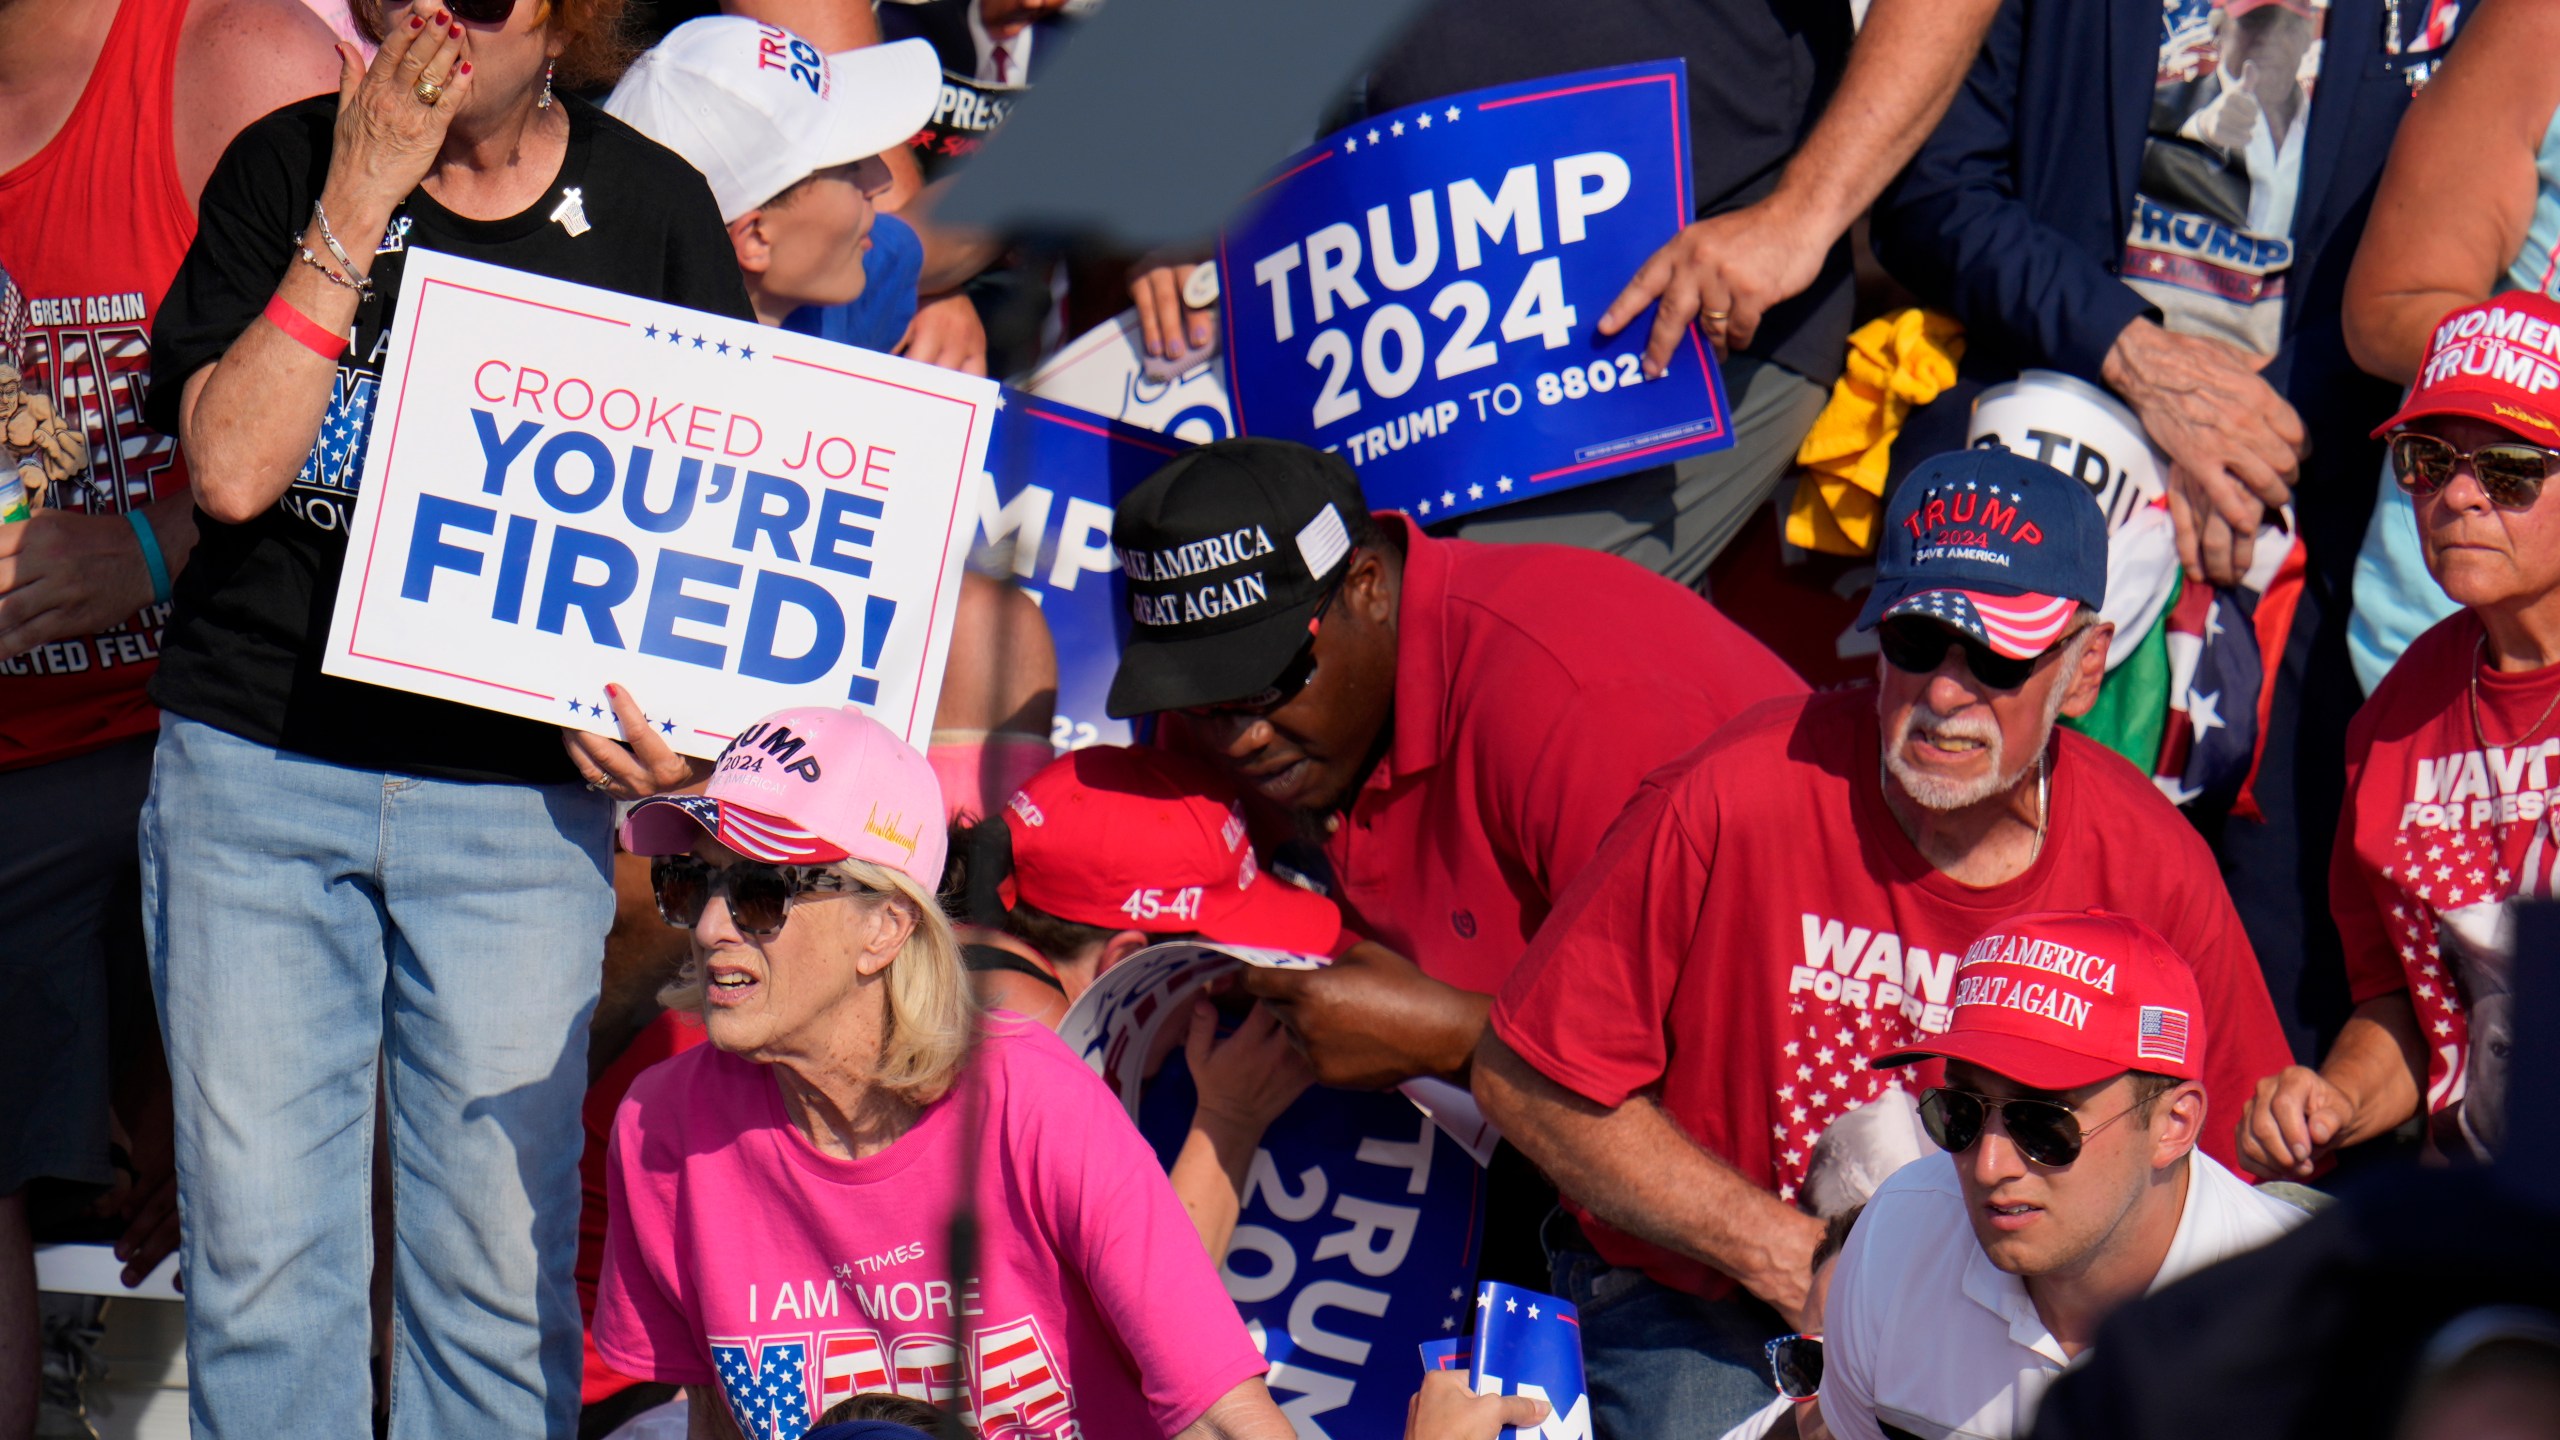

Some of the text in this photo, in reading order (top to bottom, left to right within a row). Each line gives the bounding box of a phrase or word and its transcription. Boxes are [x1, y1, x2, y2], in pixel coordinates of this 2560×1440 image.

[932, 83, 1015, 130] PRES
[1254, 151, 1632, 343] TRUMP
[30, 292, 147, 327] GREAT AGAIN
[2433, 306, 2560, 354] WOMEN
[1305, 256, 1577, 429] 2024
[2471, 336, 2508, 351] FOR
[2423, 348, 2560, 395] TRUMP
[474, 358, 764, 459] CROOKED
[782, 430, 897, 491] JOE
[1346, 400, 1460, 467] TRUMP
[1469, 382, 1522, 422] TO
[470, 406, 885, 580] YOU'RE
[1903, 492, 2044, 546] TRUMP
[1936, 529, 1989, 549] 2024
[1153, 525, 1276, 582] AMERICA
[1916, 547, 2010, 568] SAVE AMERICA!
[401, 492, 897, 706] FIRED!
[1184, 571, 1268, 622] AGAIN
[721, 755, 765, 773] 2024
[2399, 802, 2466, 831] FOR
[1121, 886, 1204, 921] 45-47
[1802, 913, 1962, 1006] WAN
[1959, 934, 2117, 995] MAKE AMERICA
[1788, 965, 1871, 1010] FOR
[1955, 976, 2093, 1031] GREAT AGAIN
[833, 1241, 926, 1280] 34 TIMES
[749, 1277, 984, 1323] I AM MORE
